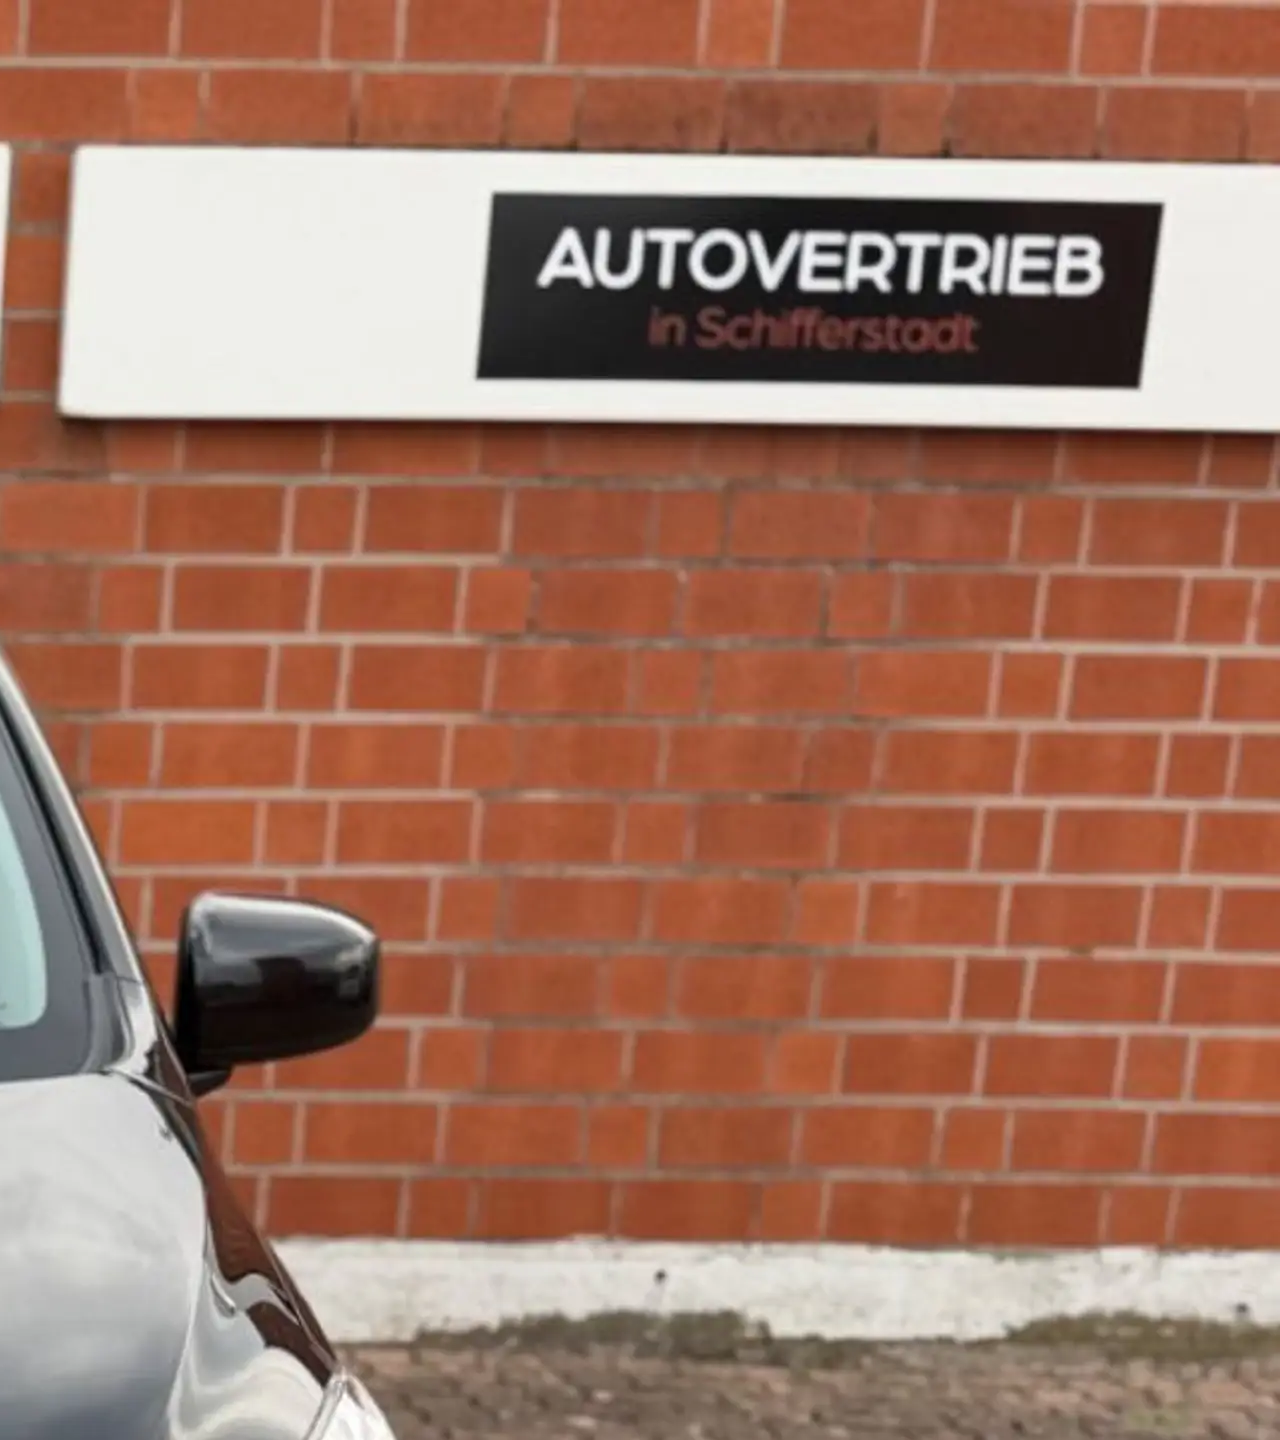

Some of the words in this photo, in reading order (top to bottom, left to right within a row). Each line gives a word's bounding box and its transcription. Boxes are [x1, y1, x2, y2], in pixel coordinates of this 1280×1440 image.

[536, 227, 1104, 297] AUTOVERTRIEB
[647, 307, 685, 349] in
[696, 306, 978, 354] Schifferstadt
